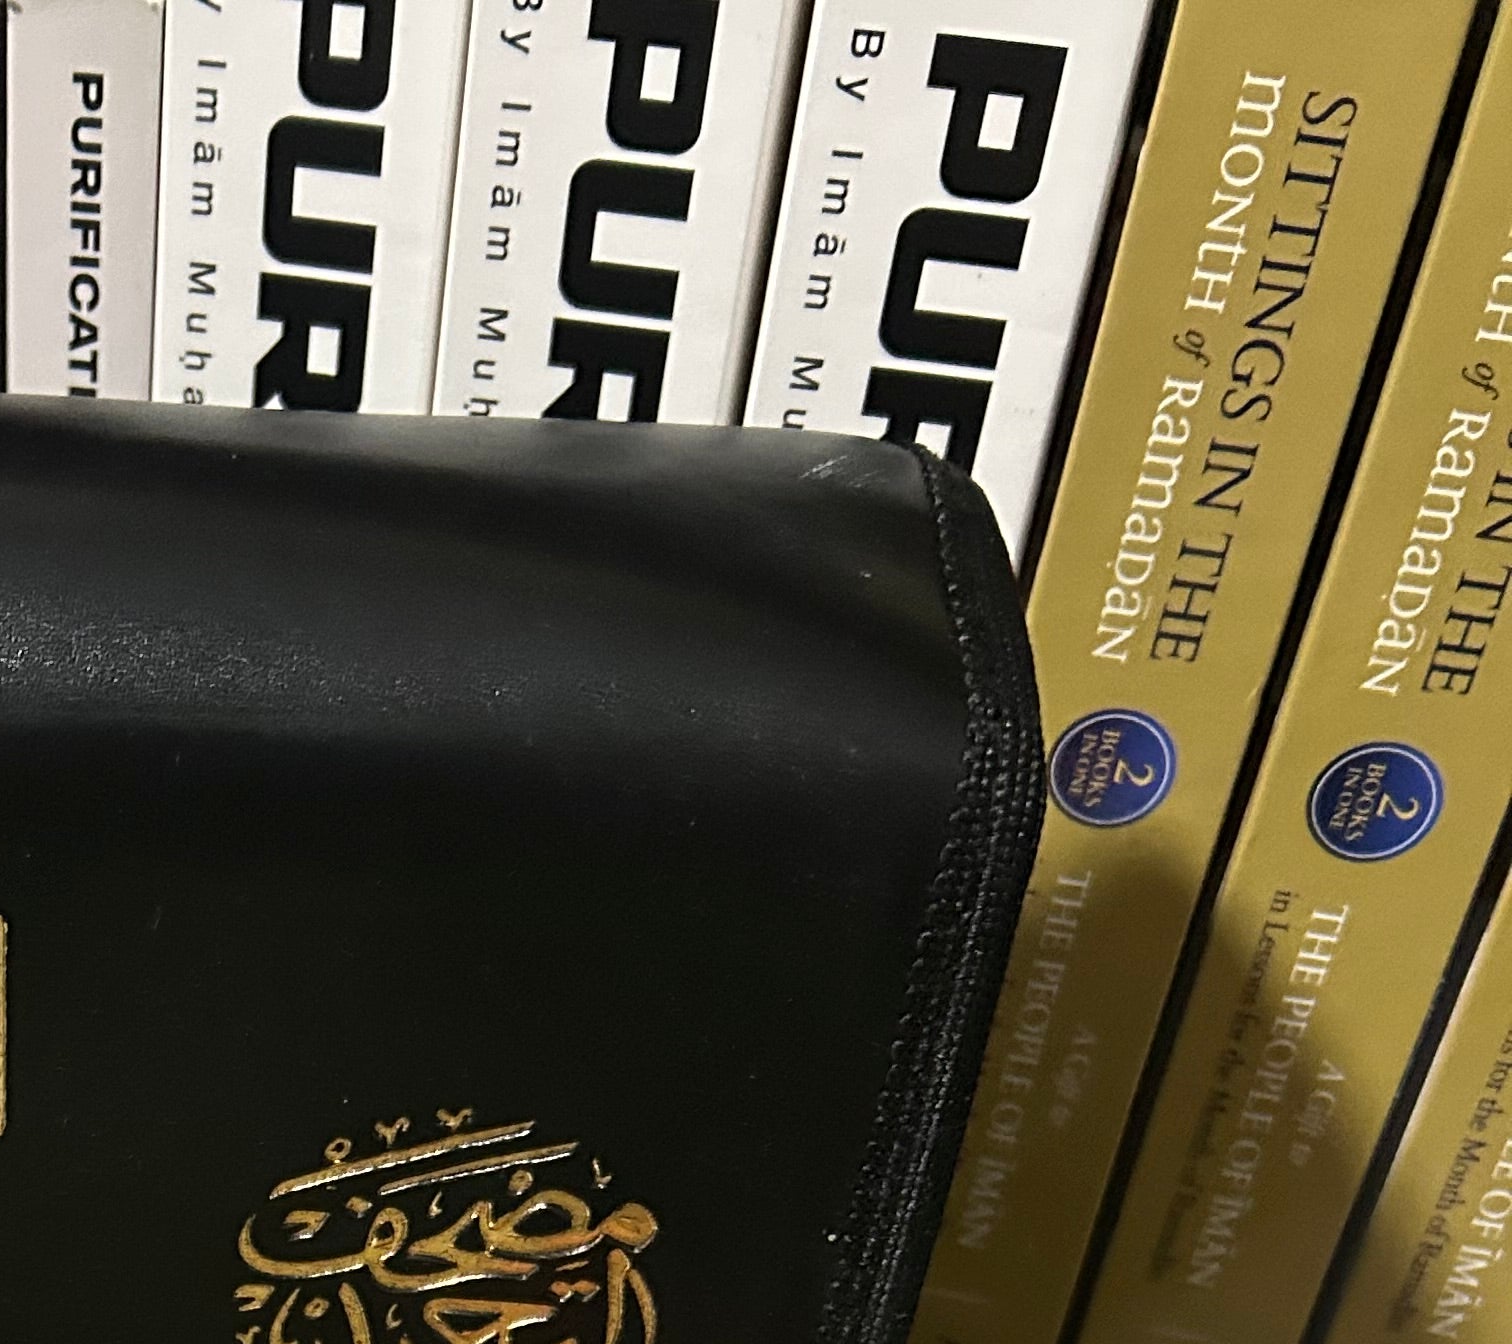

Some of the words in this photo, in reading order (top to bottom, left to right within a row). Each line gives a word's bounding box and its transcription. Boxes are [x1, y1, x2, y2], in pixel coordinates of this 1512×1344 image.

[835, 27, 886, 103] By
[1221, 90, 1360, 424] SITTINGS
[1173, 327, 1211, 367] of
[1461, 361, 1500, 401] of
[1191, 437, 1261, 519] IN
[1149, 532, 1234, 665] THE
[1067, 758, 1092, 799] ONE
[1085, 727, 1122, 808] BOOKS
[1112, 756, 1156, 788] 2
[1344, 761, 1388, 843] BOOKS
[1328, 792, 1355, 832] ONE
[1377, 792, 1421, 822] 2
[1039, 869, 1092, 951] THE
[1289, 903, 1351, 987] THE
[1002, 957, 1065, 1093] PEOPLE
[1239, 993, 1317, 1134] PEOPLE
[984, 1102, 1026, 1150] OF
[1468, 1095, 1506, 1136] the
[1219, 1138, 1265, 1190] OF
[1432, 1133, 1485, 1218] Month
